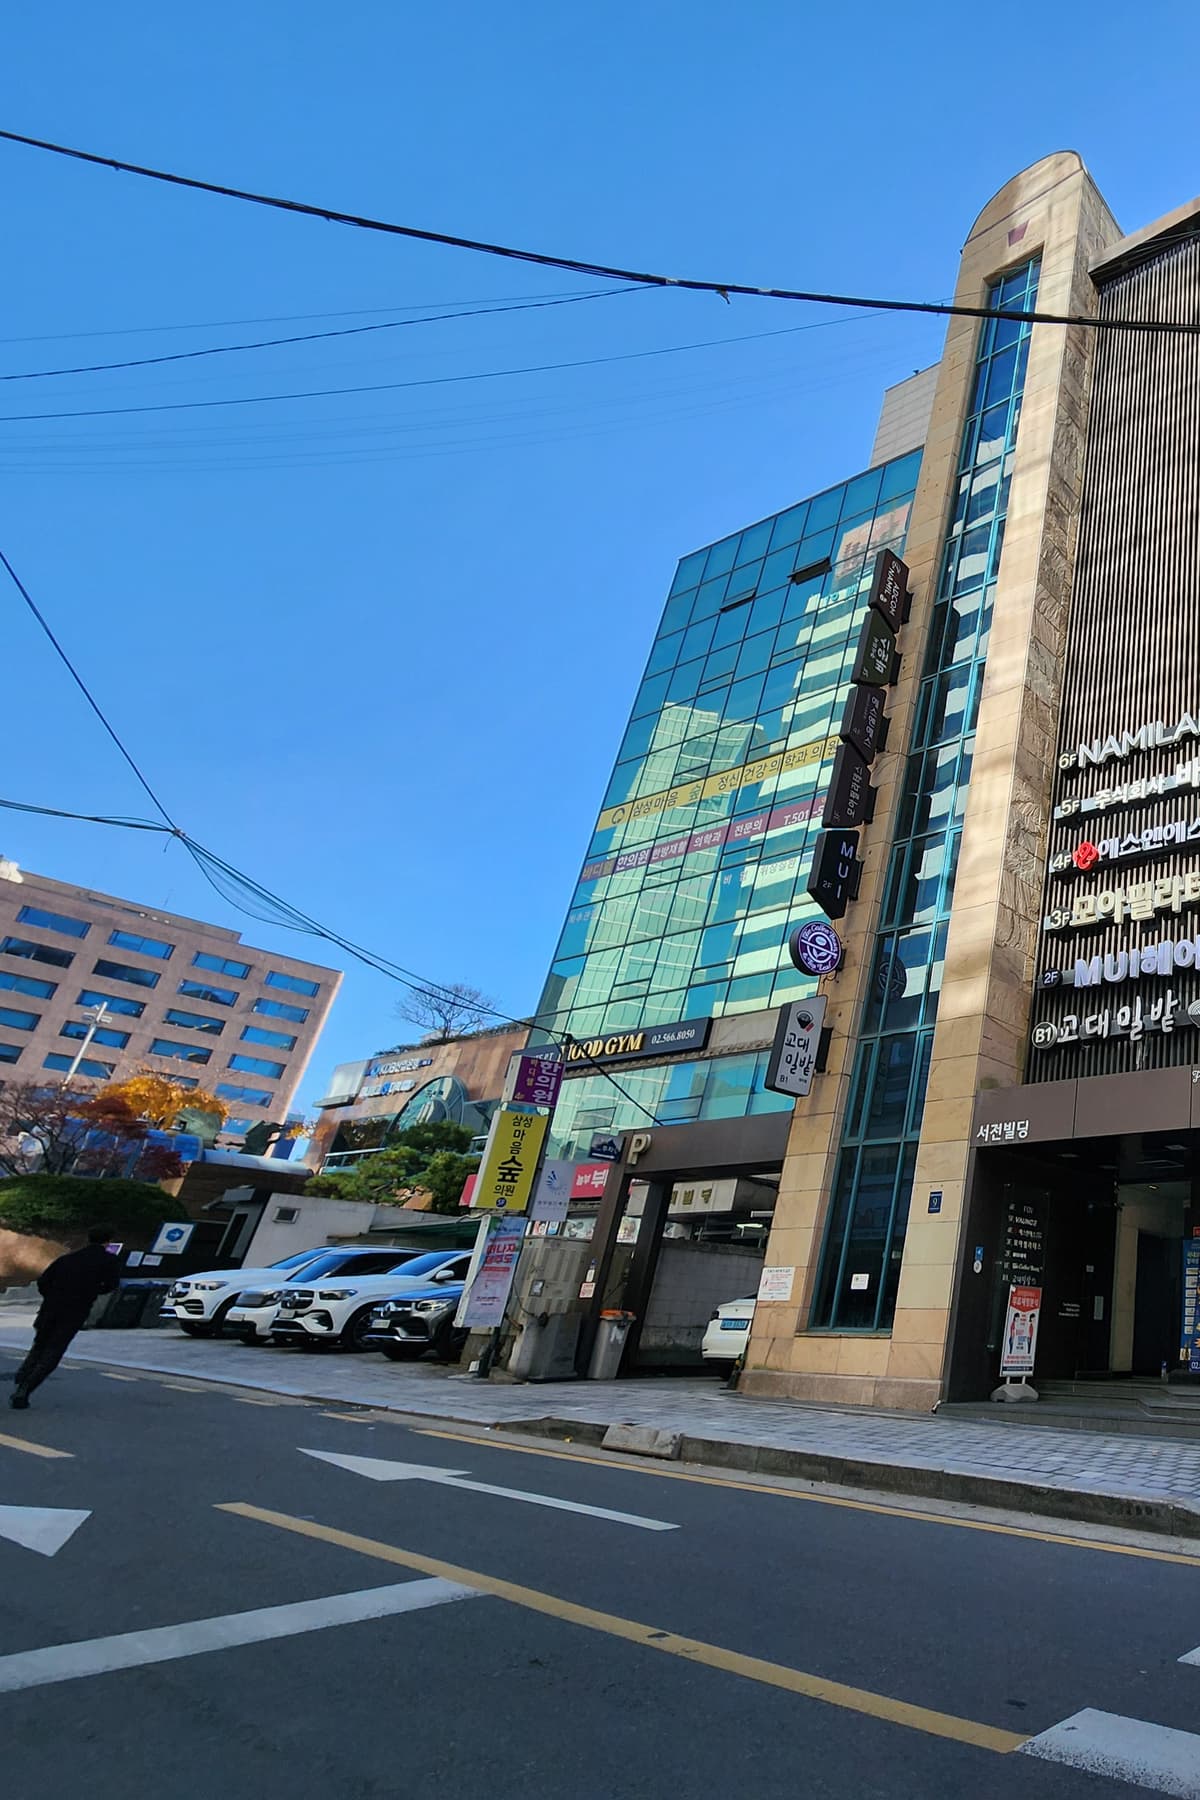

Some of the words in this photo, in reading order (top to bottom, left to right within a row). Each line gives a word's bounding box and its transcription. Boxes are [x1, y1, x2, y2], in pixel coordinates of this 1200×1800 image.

[1059, 752, 1077, 769] 6F
[1061, 800, 1080, 815] 5F
[1094, 774, 1166, 809] 주식회사
[836, 841, 854, 899] MUI
[1053, 855, 1071, 869] 4F
[1050, 910, 1070, 927] 3F
[1044, 973, 1058, 984] 2F
[605, 1033, 644, 1053] GYM
[652, 1029, 695, 1045] 02.566.8050
[1035, 1027, 1051, 1043] B1
[532, 1059, 562, 1106] 한의원
[512, 1115, 533, 1128] 삼성
[976, 1120, 1029, 1142] 서전빌딩
[493, 1184, 516, 1197] 의원
